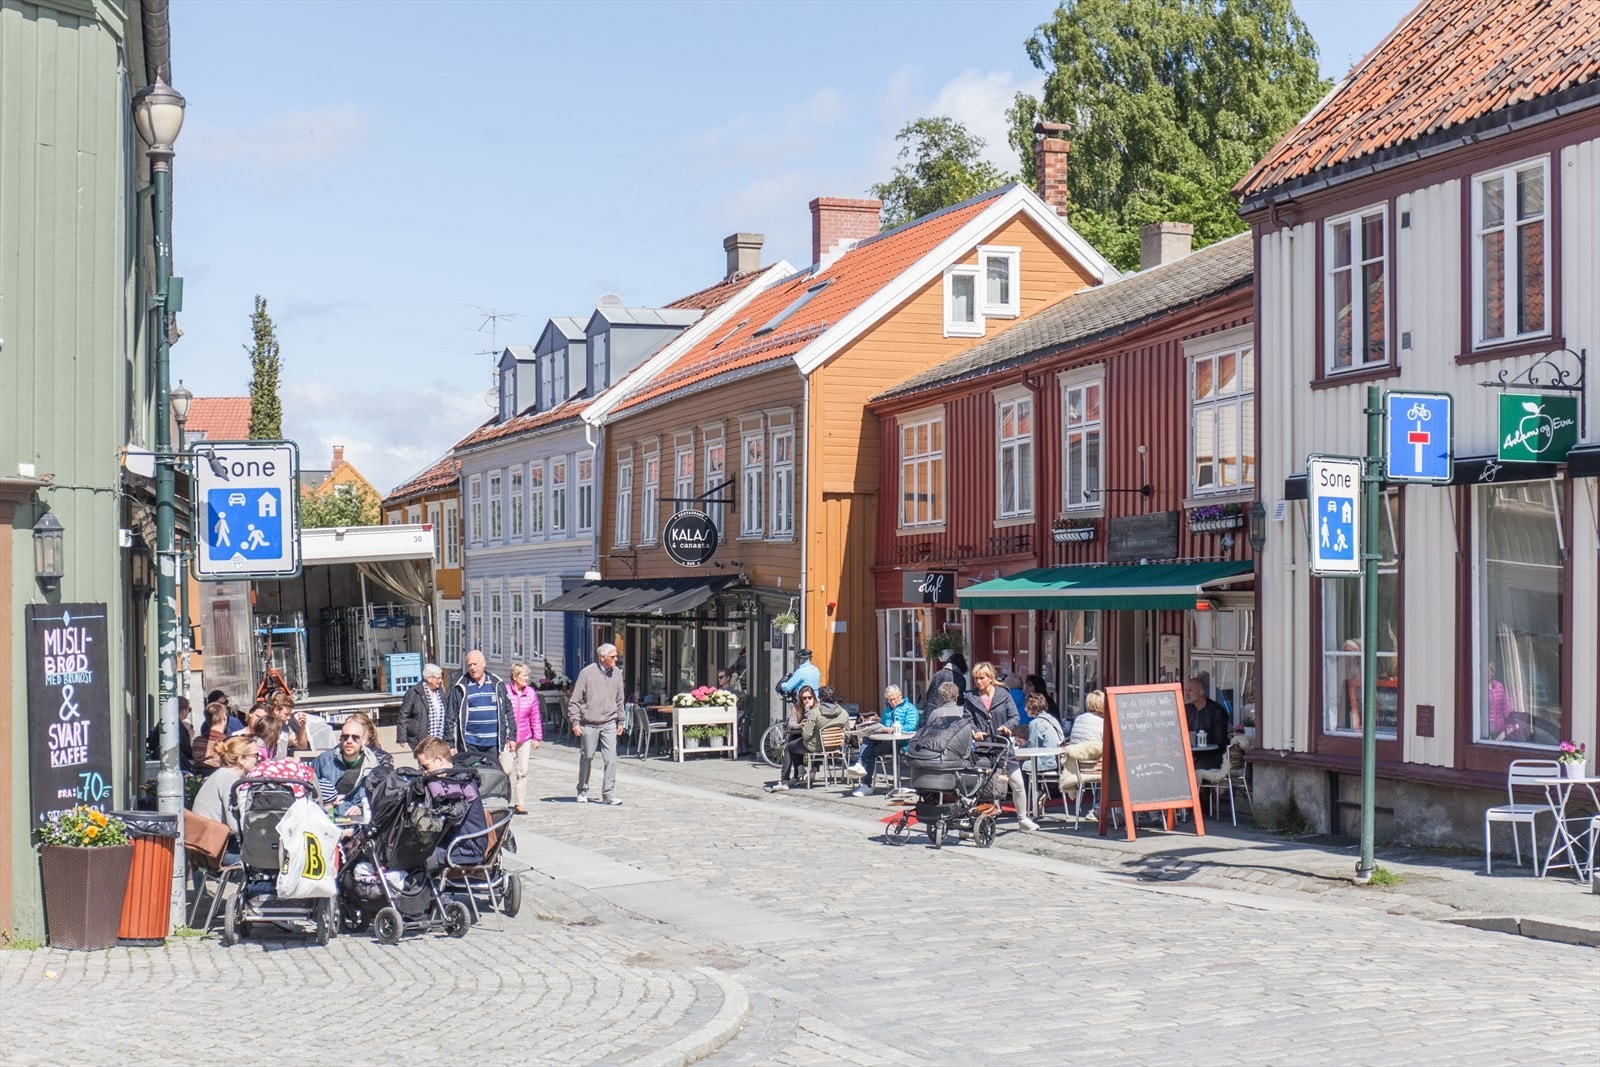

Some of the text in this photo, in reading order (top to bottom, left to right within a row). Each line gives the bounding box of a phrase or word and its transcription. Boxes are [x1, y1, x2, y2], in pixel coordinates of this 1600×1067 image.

[1503, 417, 1575, 449] Adam og Eva
[1320, 468, 1351, 488] Sone
[672, 528, 710, 541] KALAS
[44, 654, 88, 674] BRØD
[45, 673, 61, 686] MED
[58, 684, 80, 721] &
[48, 720, 90, 750] SVART
[50, 746, 88, 766] KAFFE
[302, 831, 326, 880] B
